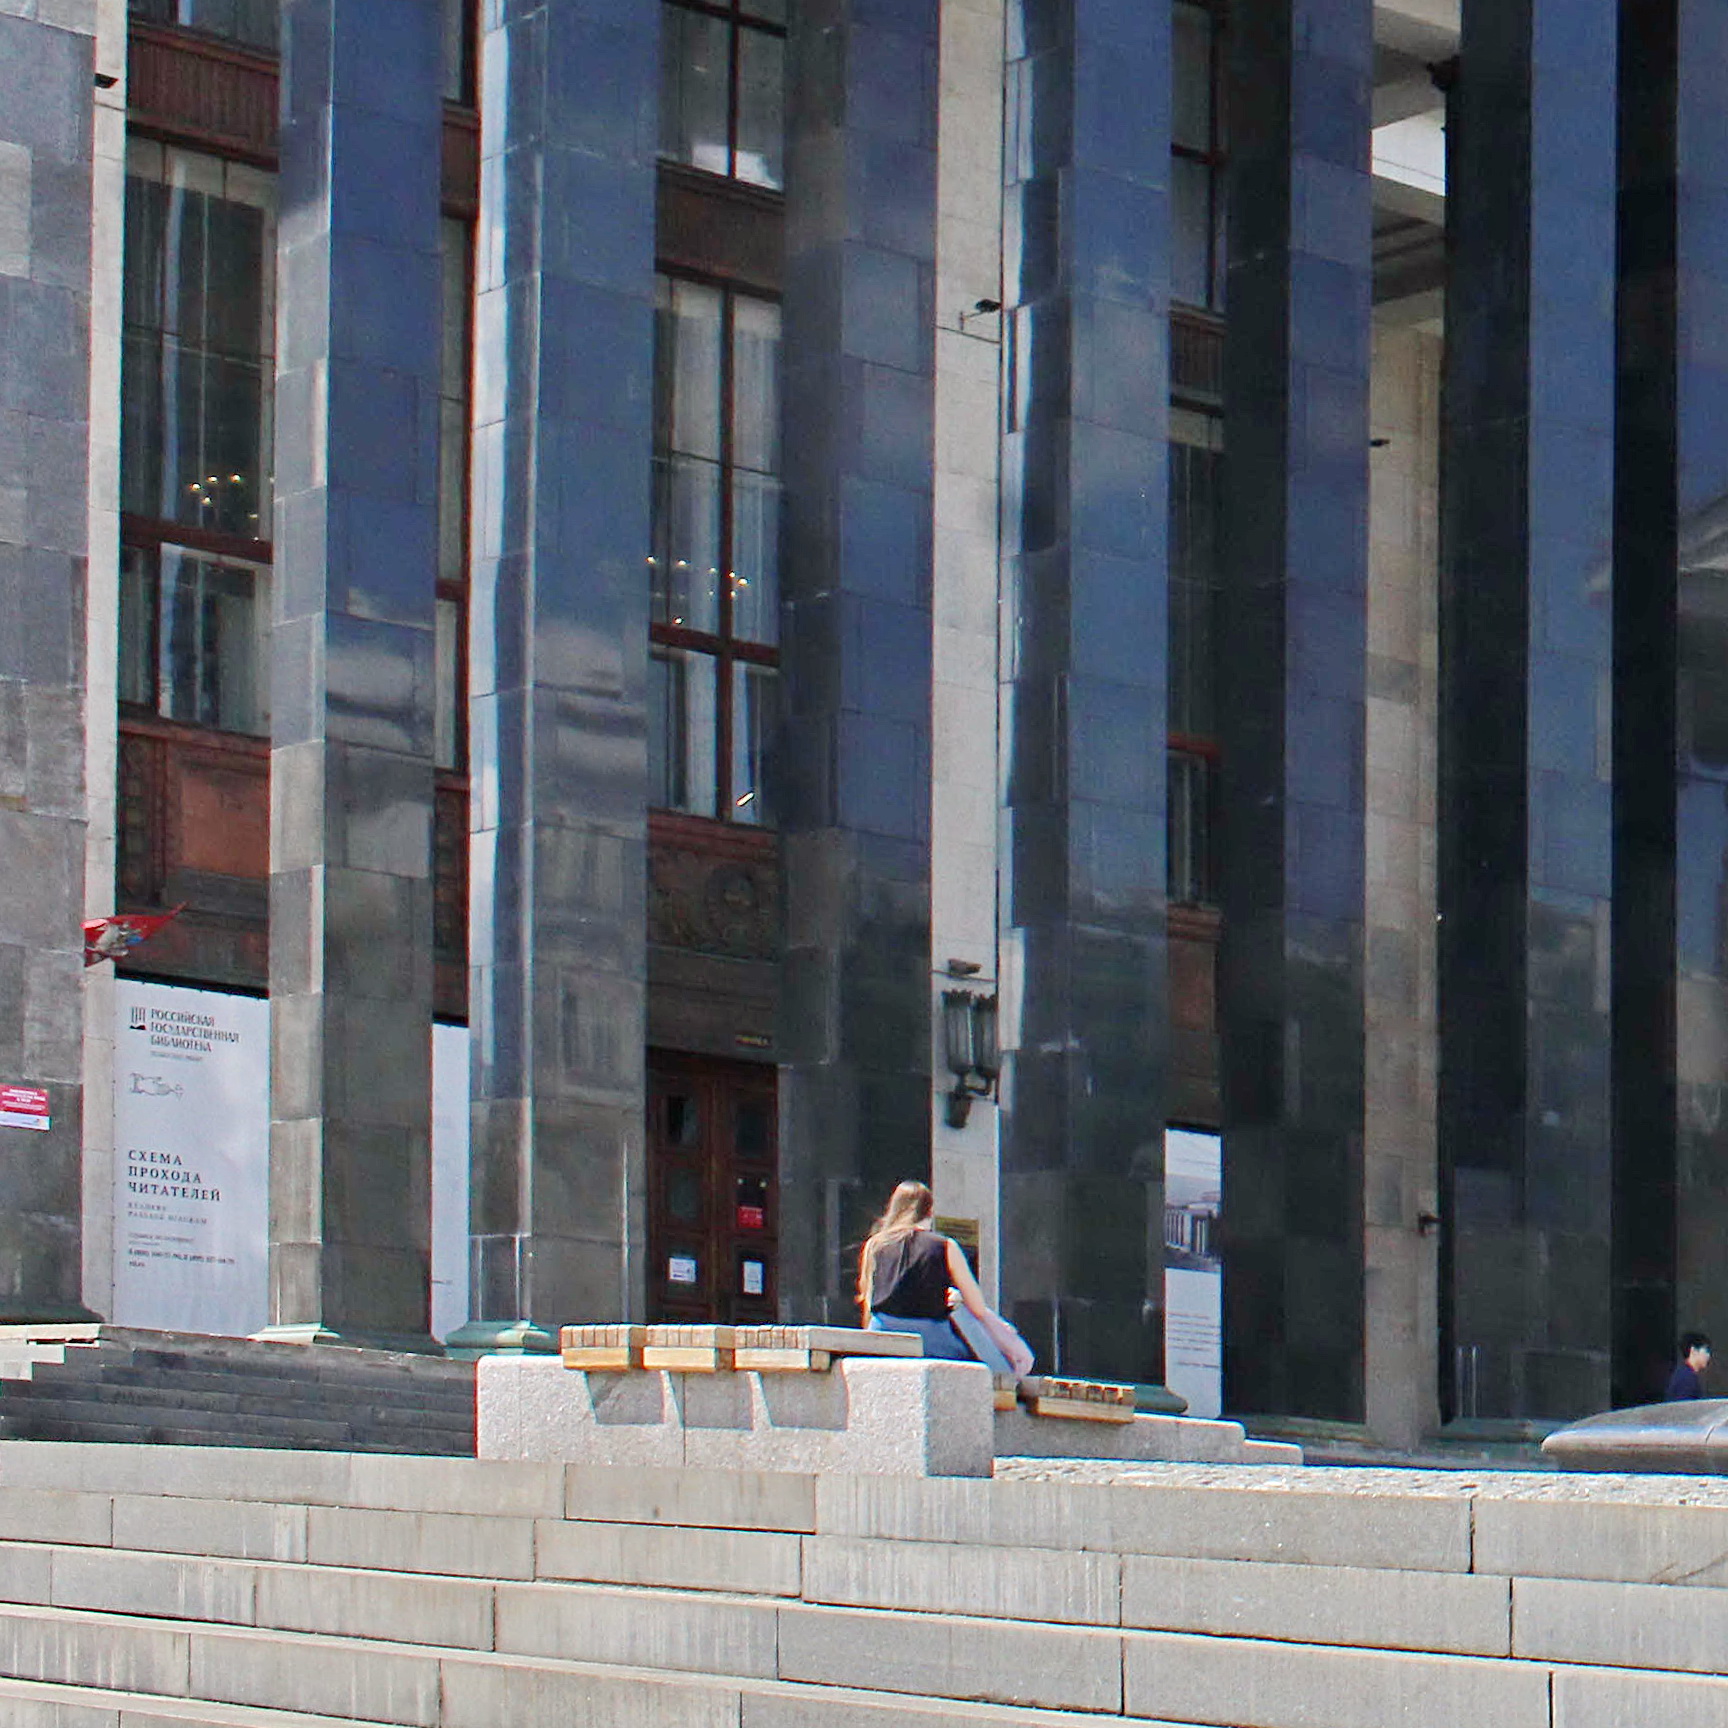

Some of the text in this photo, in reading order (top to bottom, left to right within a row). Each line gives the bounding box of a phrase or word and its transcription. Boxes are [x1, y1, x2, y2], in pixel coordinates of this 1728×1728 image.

[128, 1150, 182, 1165] СХЕМА
[128, 1166, 202, 1184] ПРОХОДА
[128, 1182, 221, 1201] ЧИТАТЕЛЕЙ
